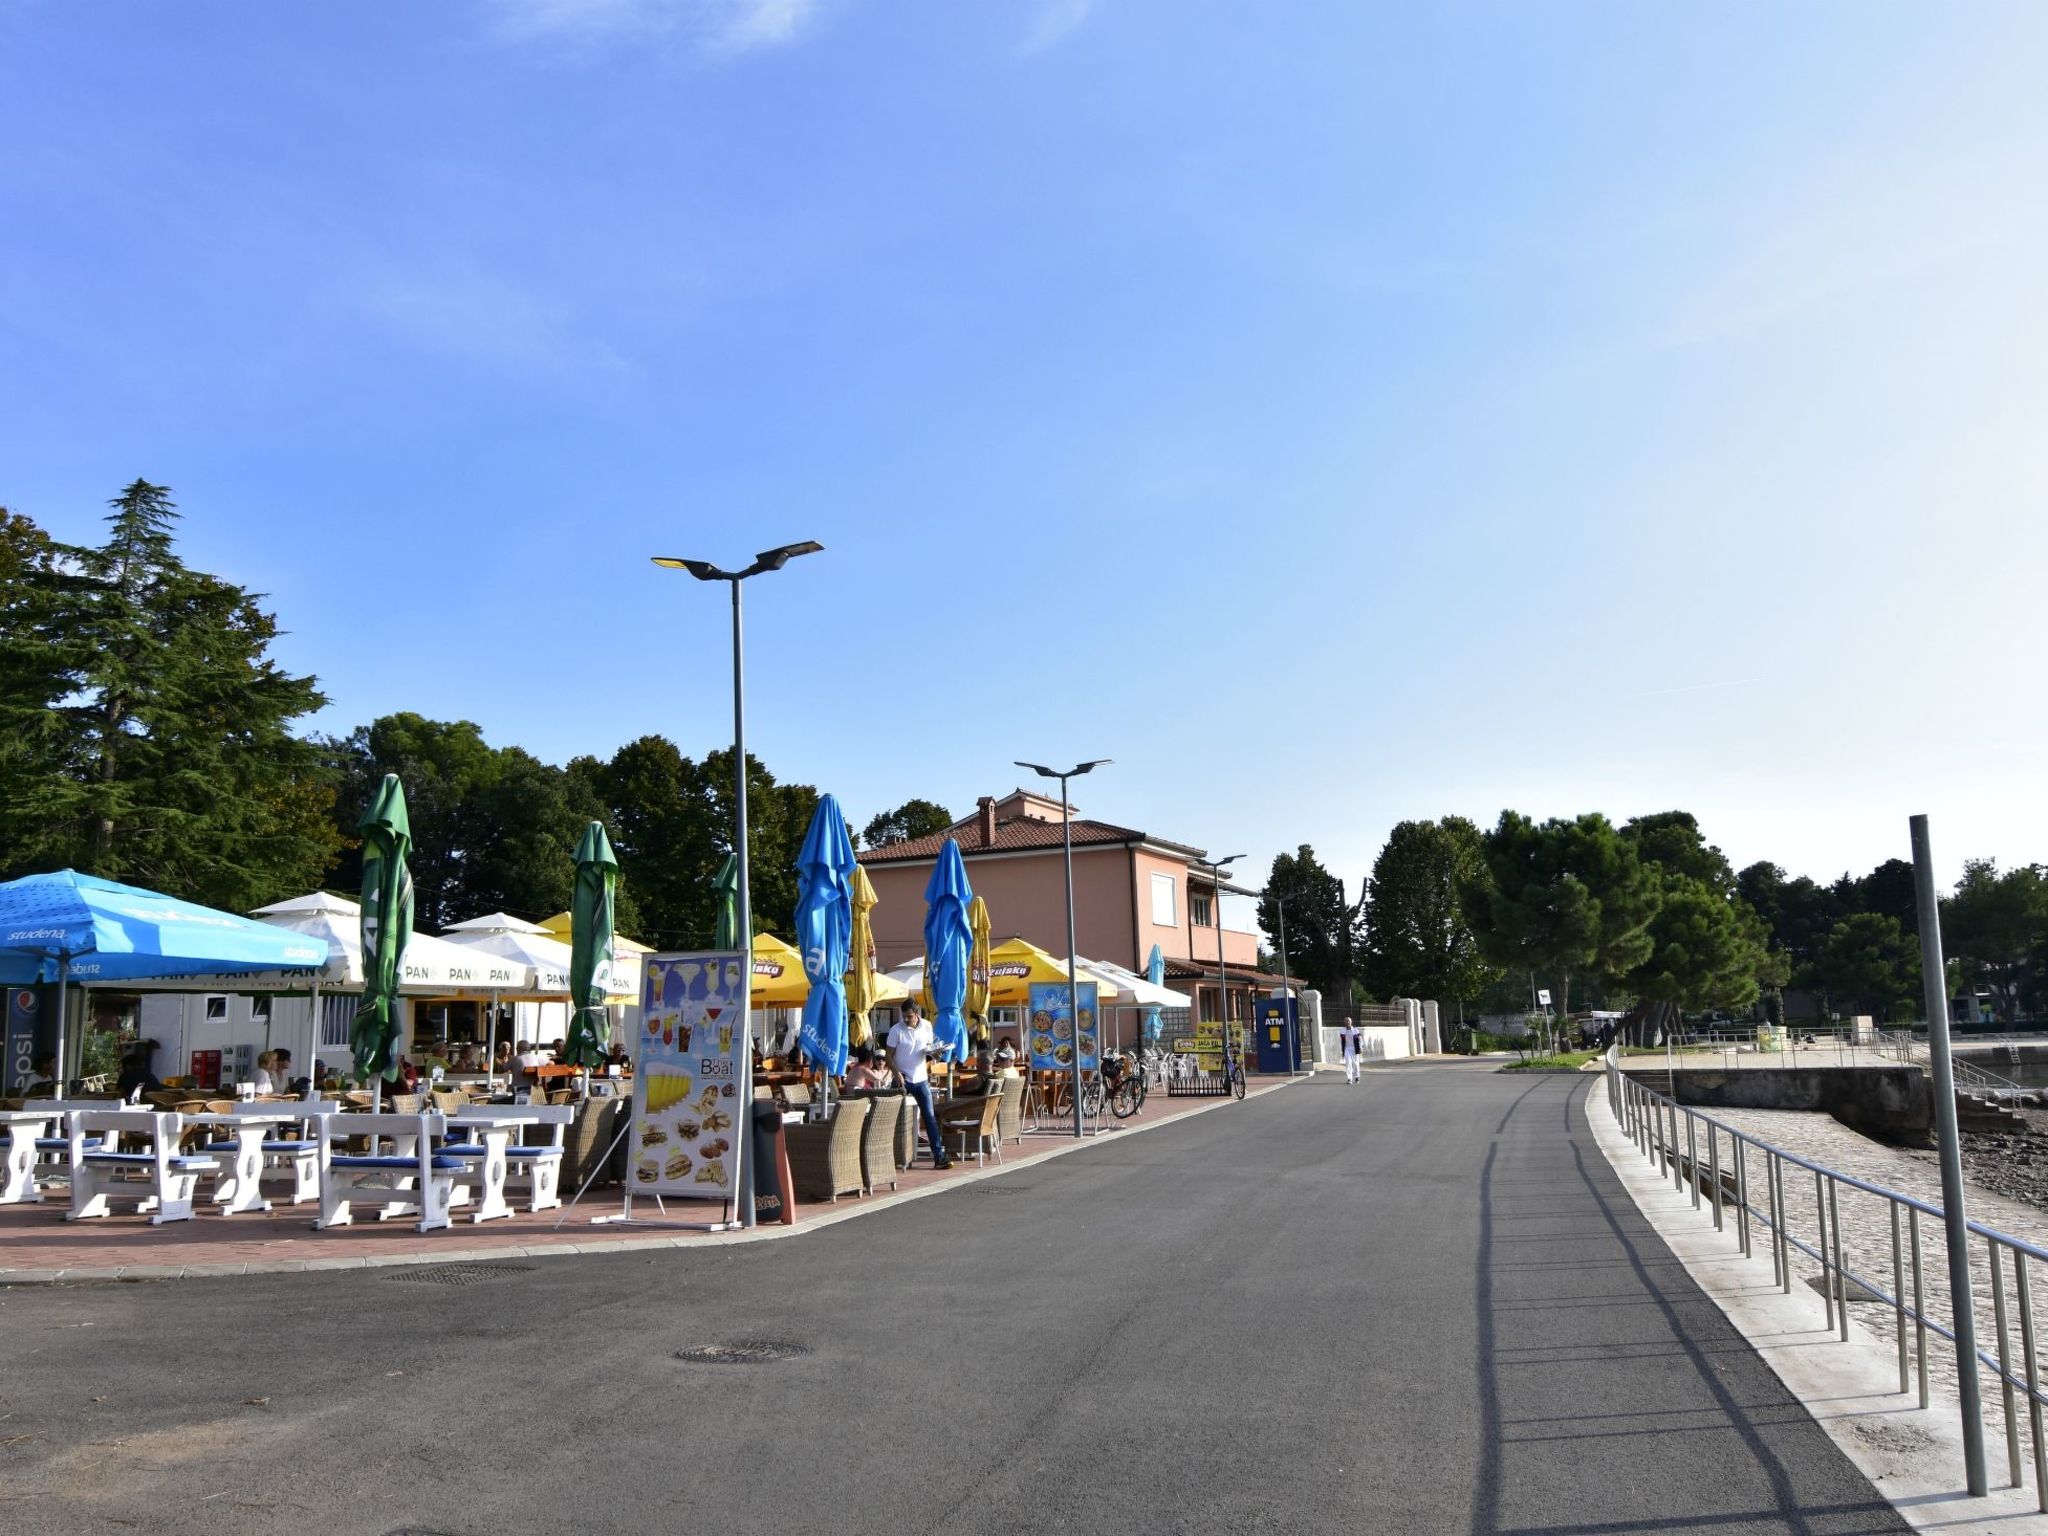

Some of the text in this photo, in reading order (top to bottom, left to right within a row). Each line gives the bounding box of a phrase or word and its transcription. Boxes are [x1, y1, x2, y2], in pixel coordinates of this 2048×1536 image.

[7, 928, 66, 940] studena
[405, 966, 511, 981] PAN PAN PAN
[547, 973, 566, 986] PAN
[612, 978, 630, 989] PAN
[1265, 1018, 1285, 1026] ATM
[802, 1023, 837, 1061] studena
[701, 1058, 733, 1075] Boat
